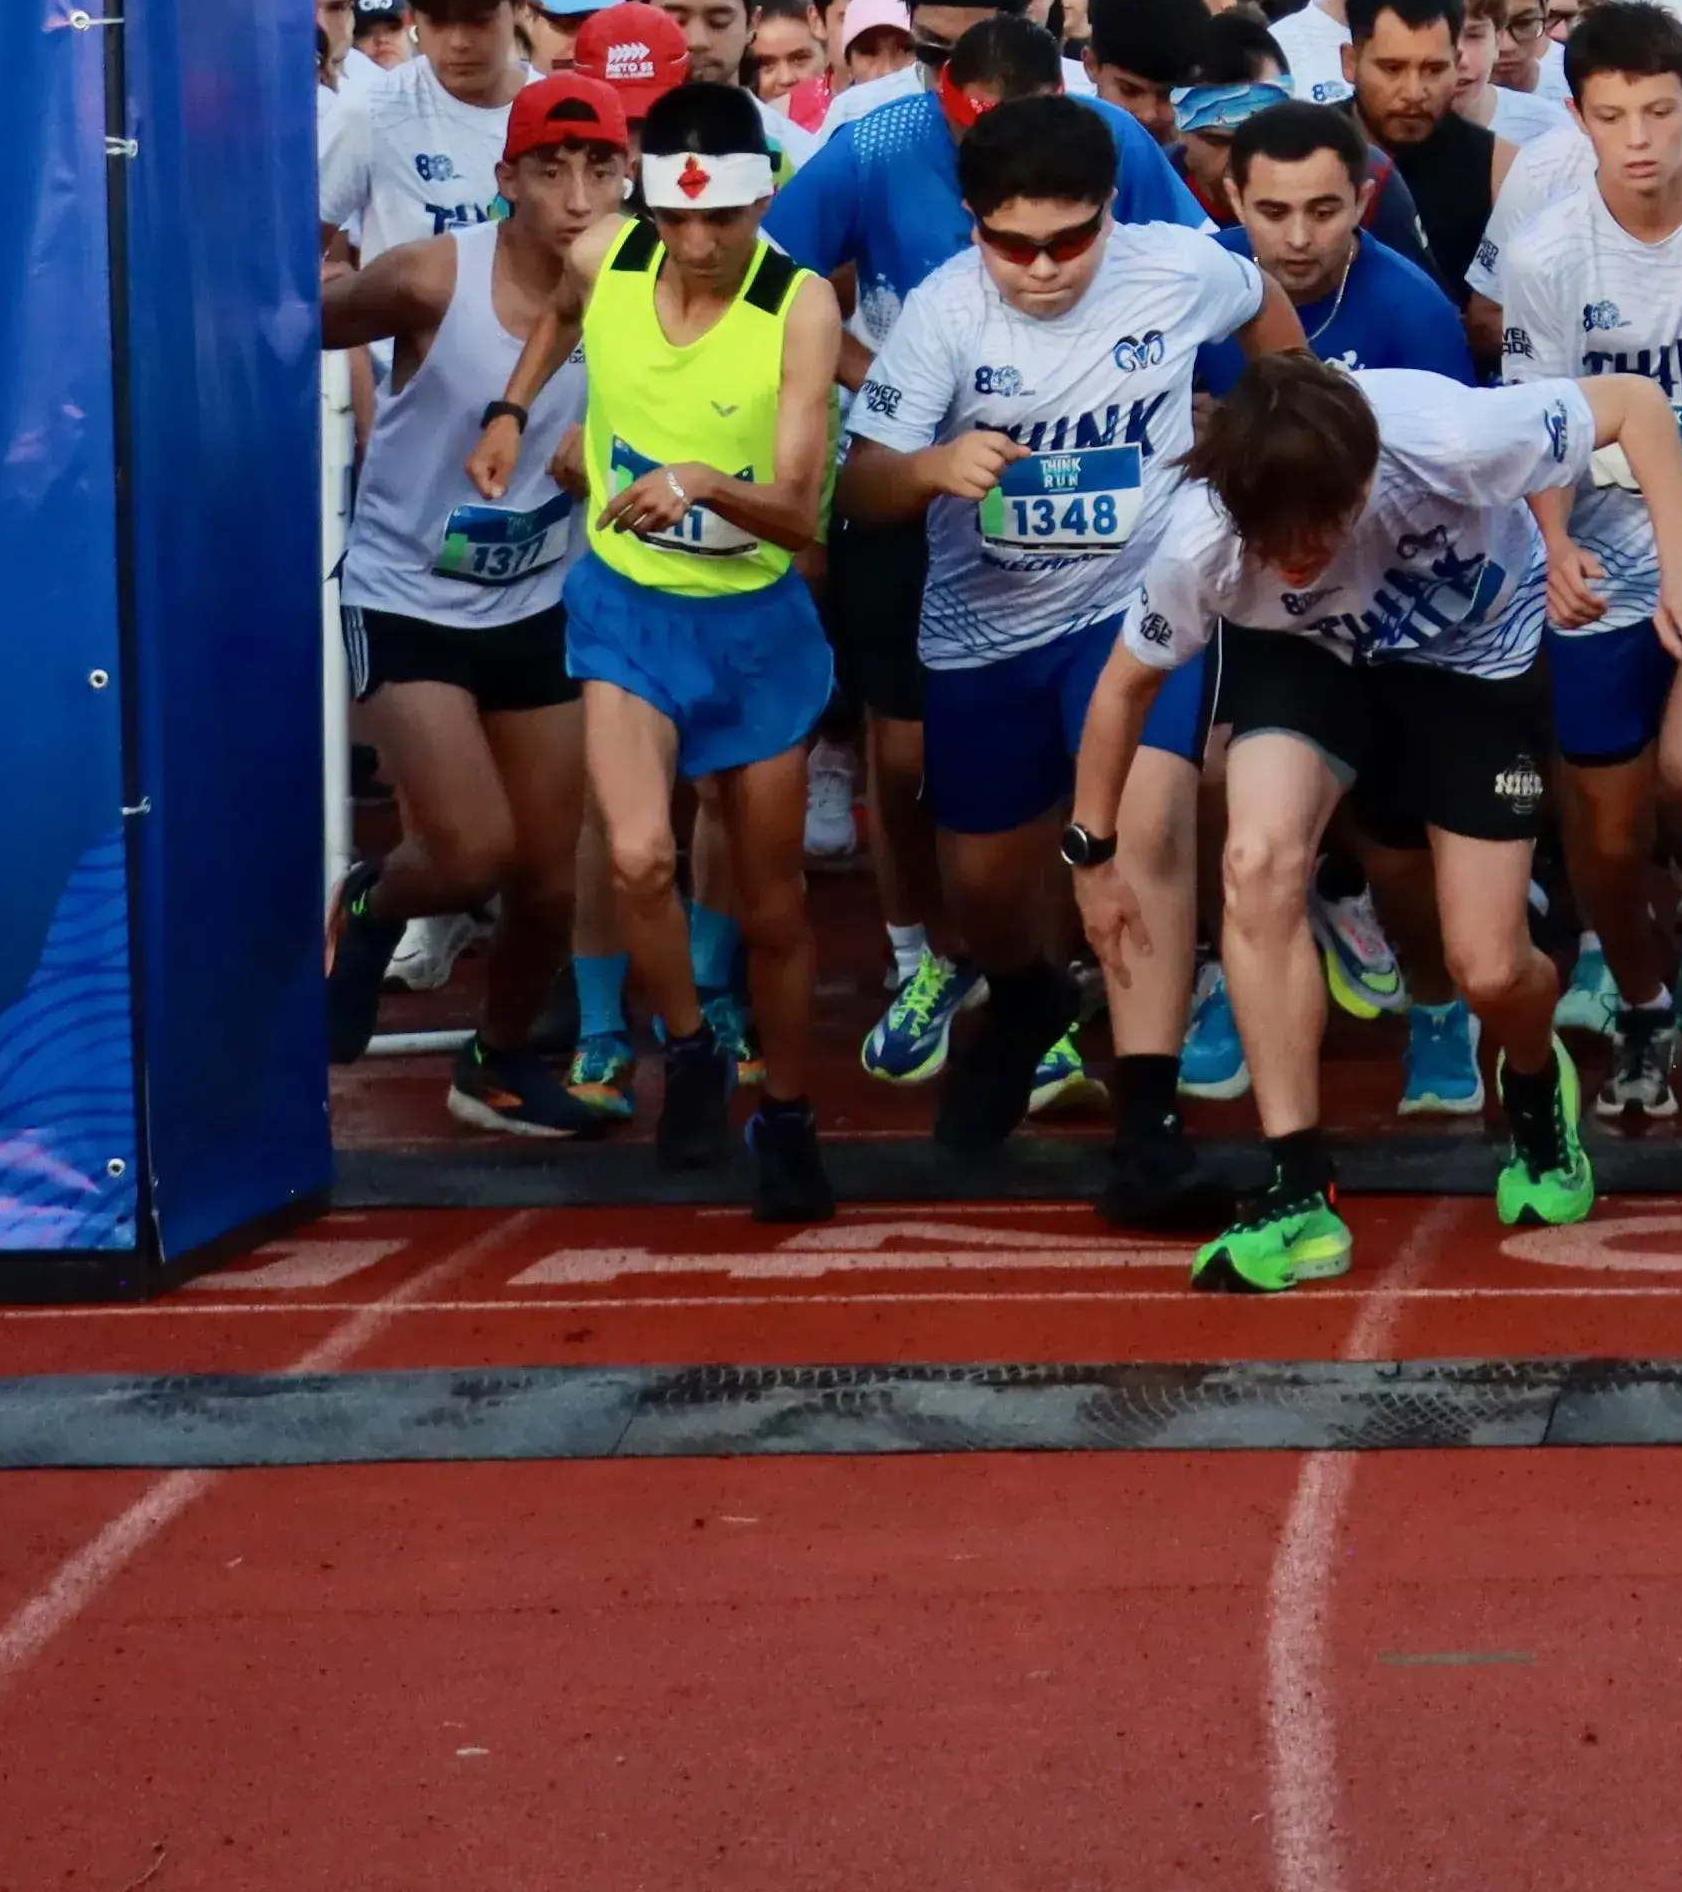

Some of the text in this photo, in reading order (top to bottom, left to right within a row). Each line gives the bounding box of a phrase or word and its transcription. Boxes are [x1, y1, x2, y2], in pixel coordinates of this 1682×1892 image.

[1041, 458, 1082, 475] THINK
[1045, 474, 1079, 489] RUN
[1013, 495, 1116, 537] 1348
[472, 532, 544, 576] 1377
